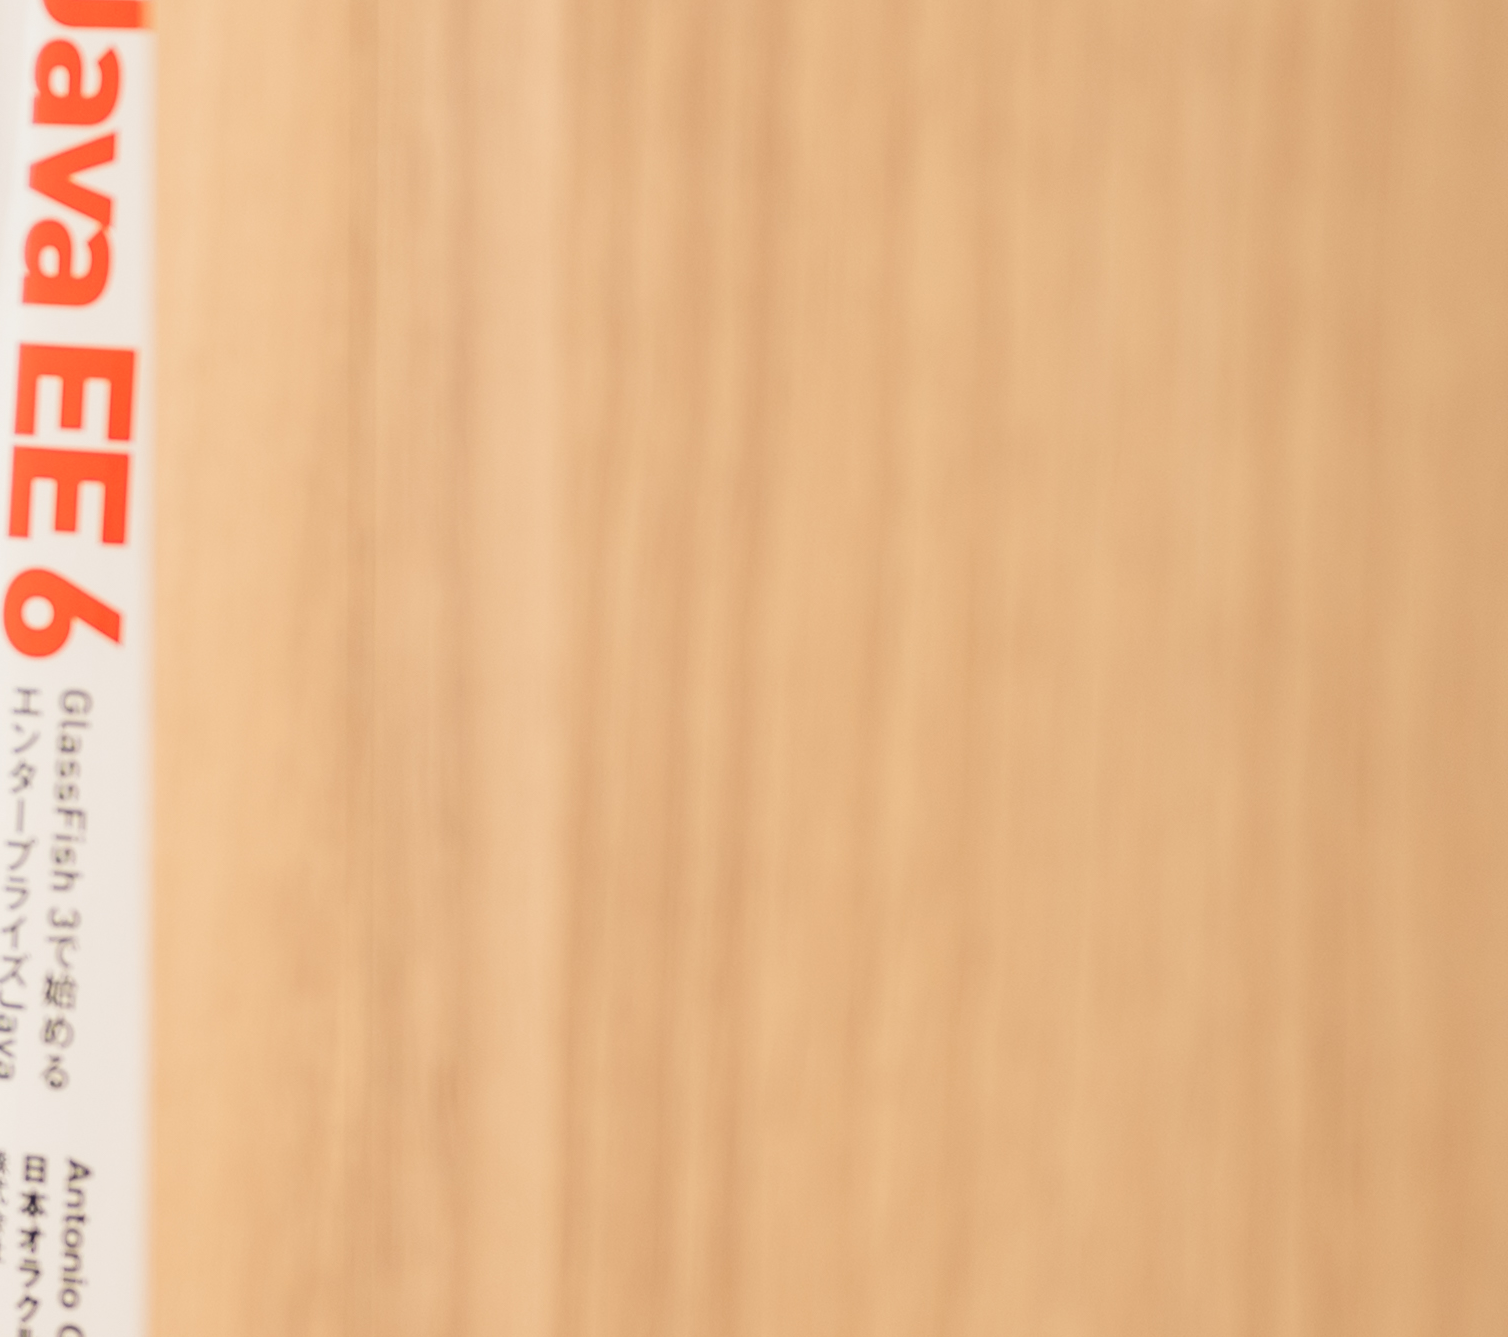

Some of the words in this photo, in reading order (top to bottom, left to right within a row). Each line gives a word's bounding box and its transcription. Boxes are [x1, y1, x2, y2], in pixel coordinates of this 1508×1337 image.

[8, 341, 138, 546] EE
[3, 567, 123, 659] 6
[49, 688, 94, 893] GlassFish
[59, 1158, 93, 1310] Antonio
